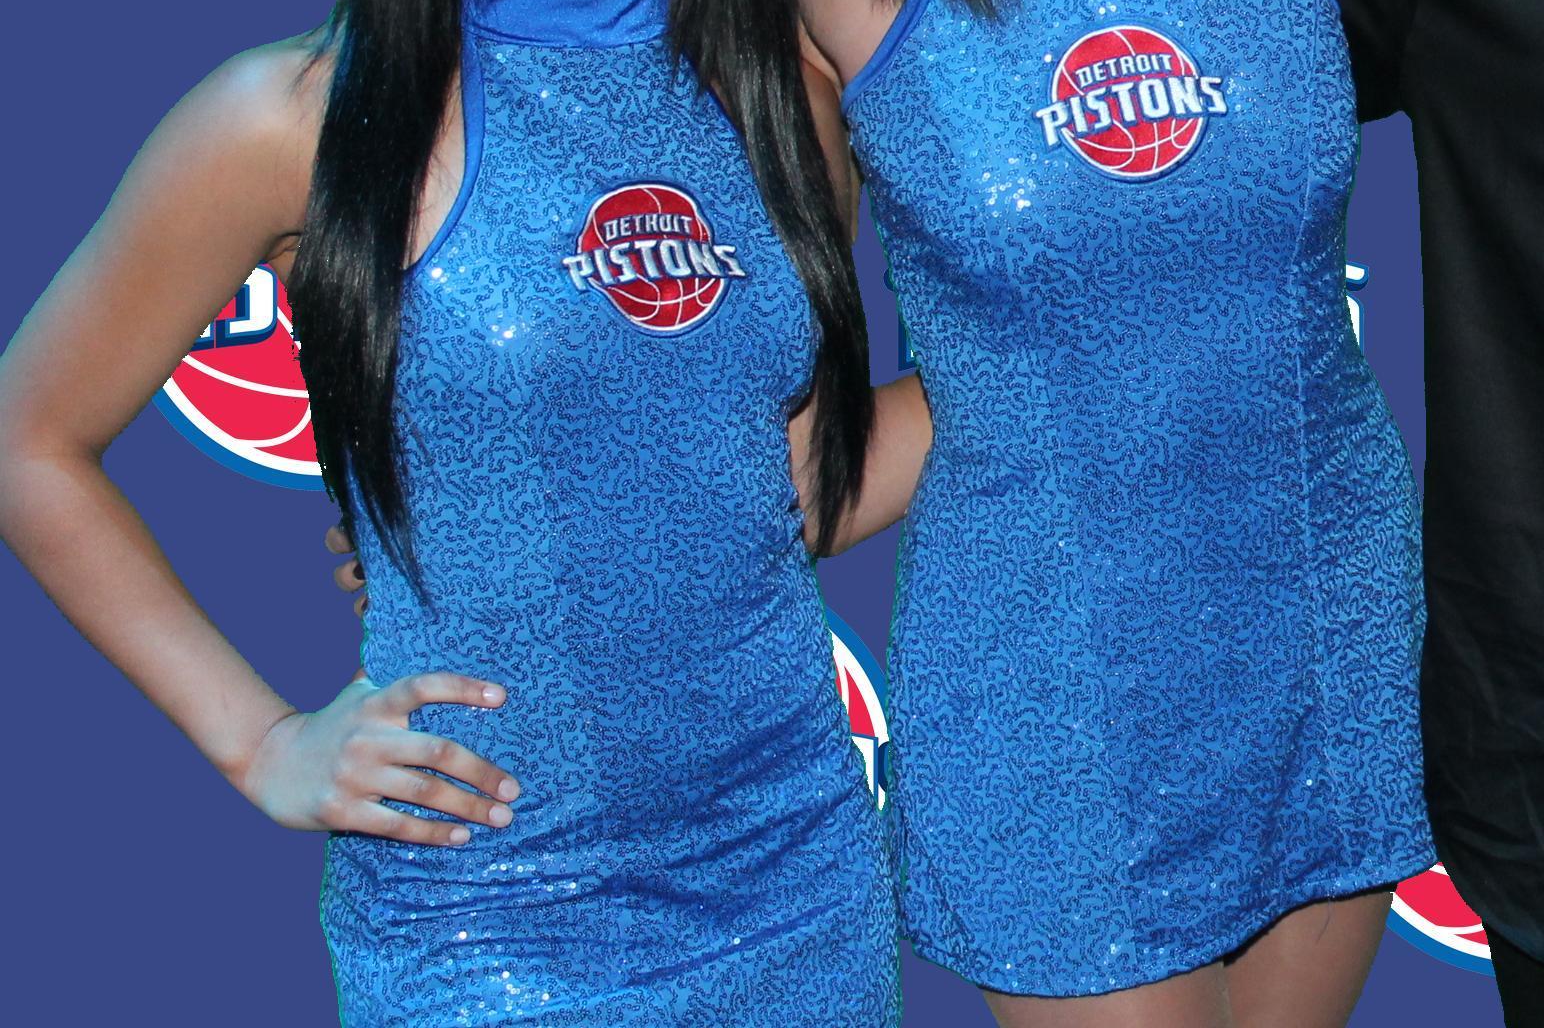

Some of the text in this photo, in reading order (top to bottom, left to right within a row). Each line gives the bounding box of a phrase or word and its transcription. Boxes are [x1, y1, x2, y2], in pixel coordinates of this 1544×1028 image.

[1075, 54, 1173, 88] DETROIT
[1035, 76, 1228, 147] PISTONS
[603, 213, 693, 241] DETROIT
[562, 239, 747, 291] PISTONS
